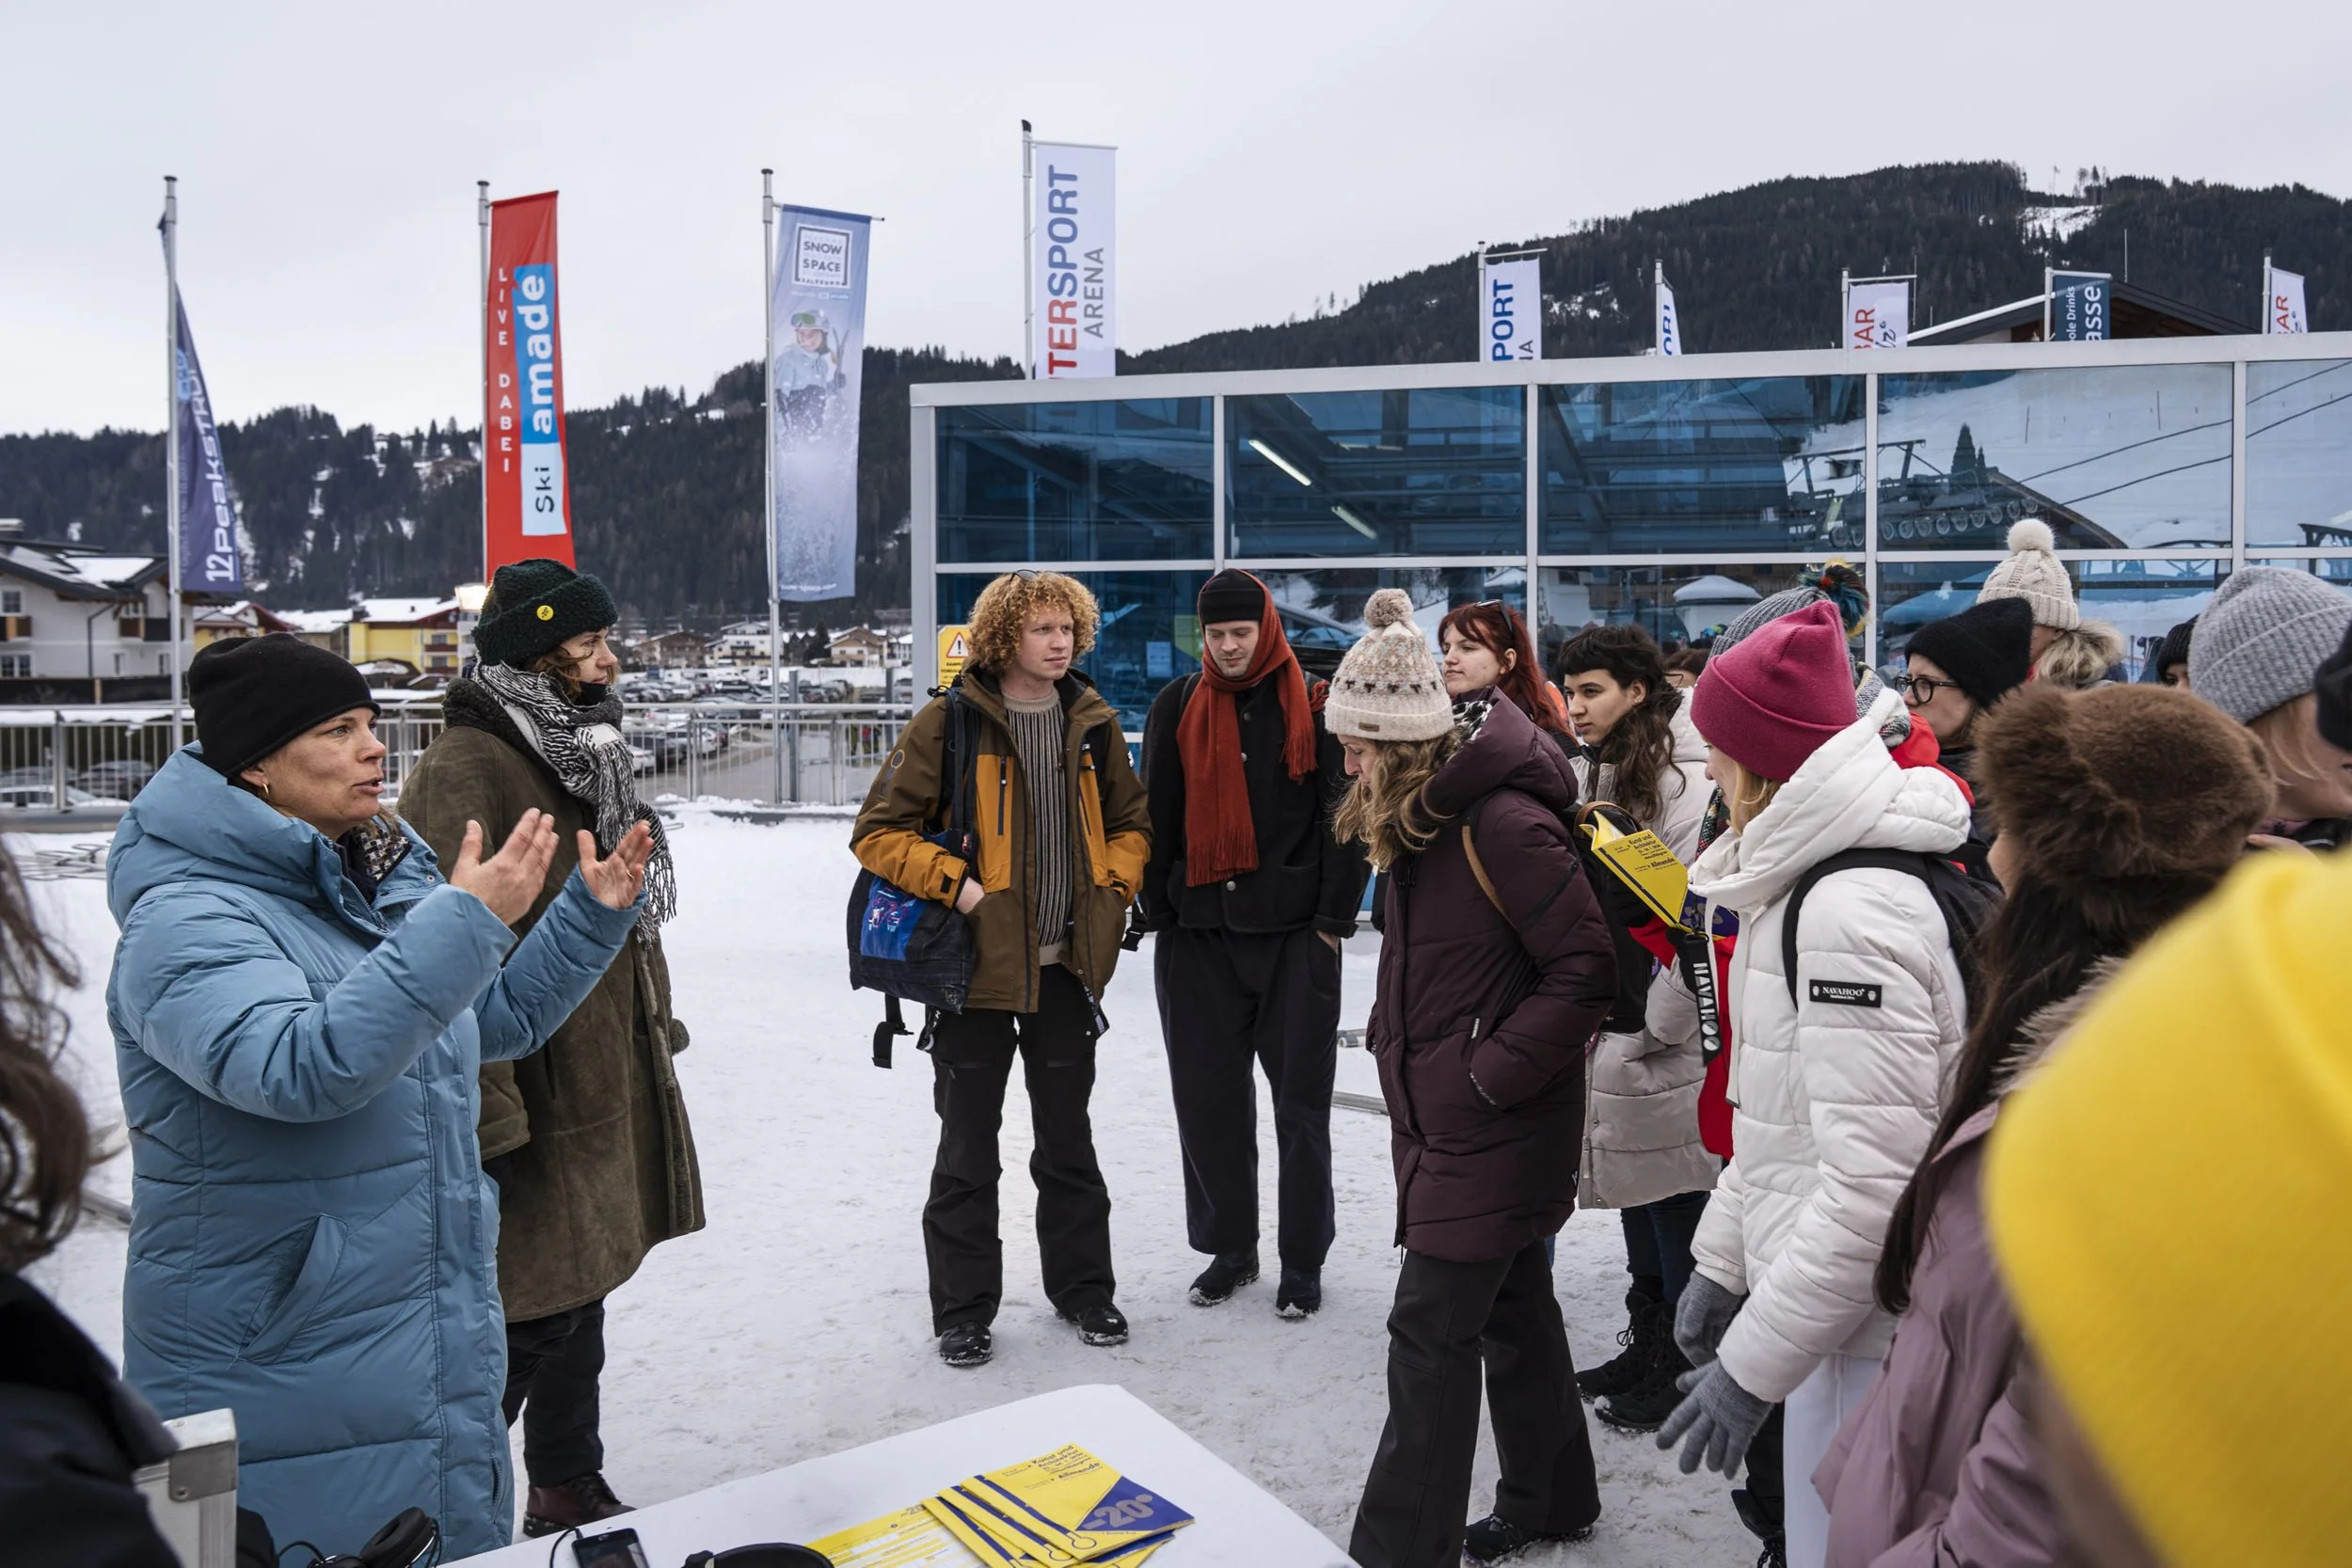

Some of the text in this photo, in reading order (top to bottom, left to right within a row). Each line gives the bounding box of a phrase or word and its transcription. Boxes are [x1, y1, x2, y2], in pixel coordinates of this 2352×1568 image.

[802, 258, 841, 273] SPACE
[803, 240, 843, 255] SNOW
[1047, 165, 1078, 379] TERSPORT
[1084, 247, 1104, 339] ARENA
[2065, 286, 2077, 321] Drinks
[2276, 295, 2291, 334] AR
[498, 267, 513, 473] LIVE DABEI
[534, 467, 555, 514] Ski
[1057, 1444, 1074, 1455] und
